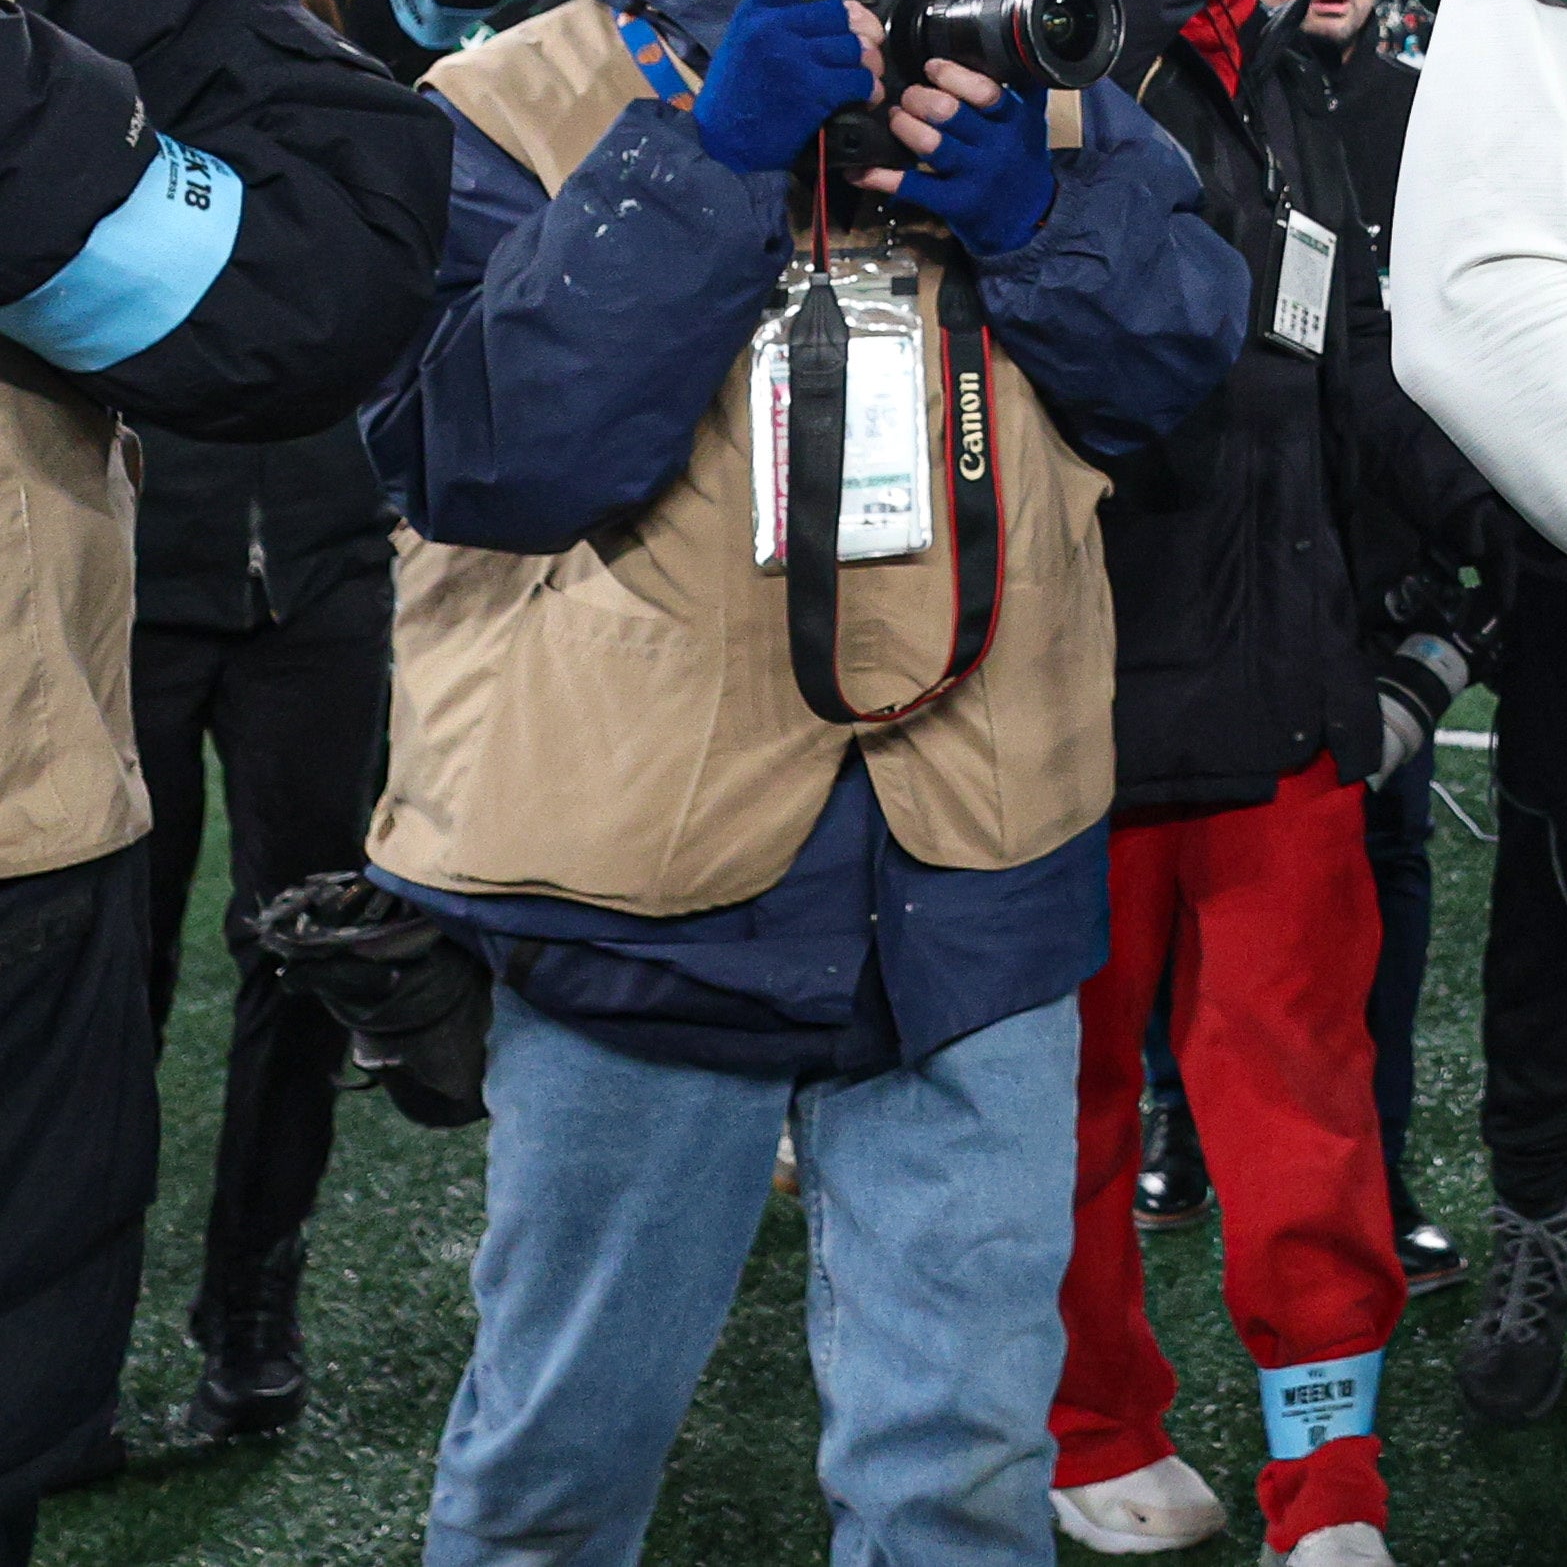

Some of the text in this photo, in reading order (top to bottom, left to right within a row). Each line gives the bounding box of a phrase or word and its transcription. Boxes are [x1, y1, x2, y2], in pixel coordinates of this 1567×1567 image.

[184, 180, 212, 211] 18
[959, 372, 986, 481] Canon
[1283, 1381, 1335, 1406] WEEK
